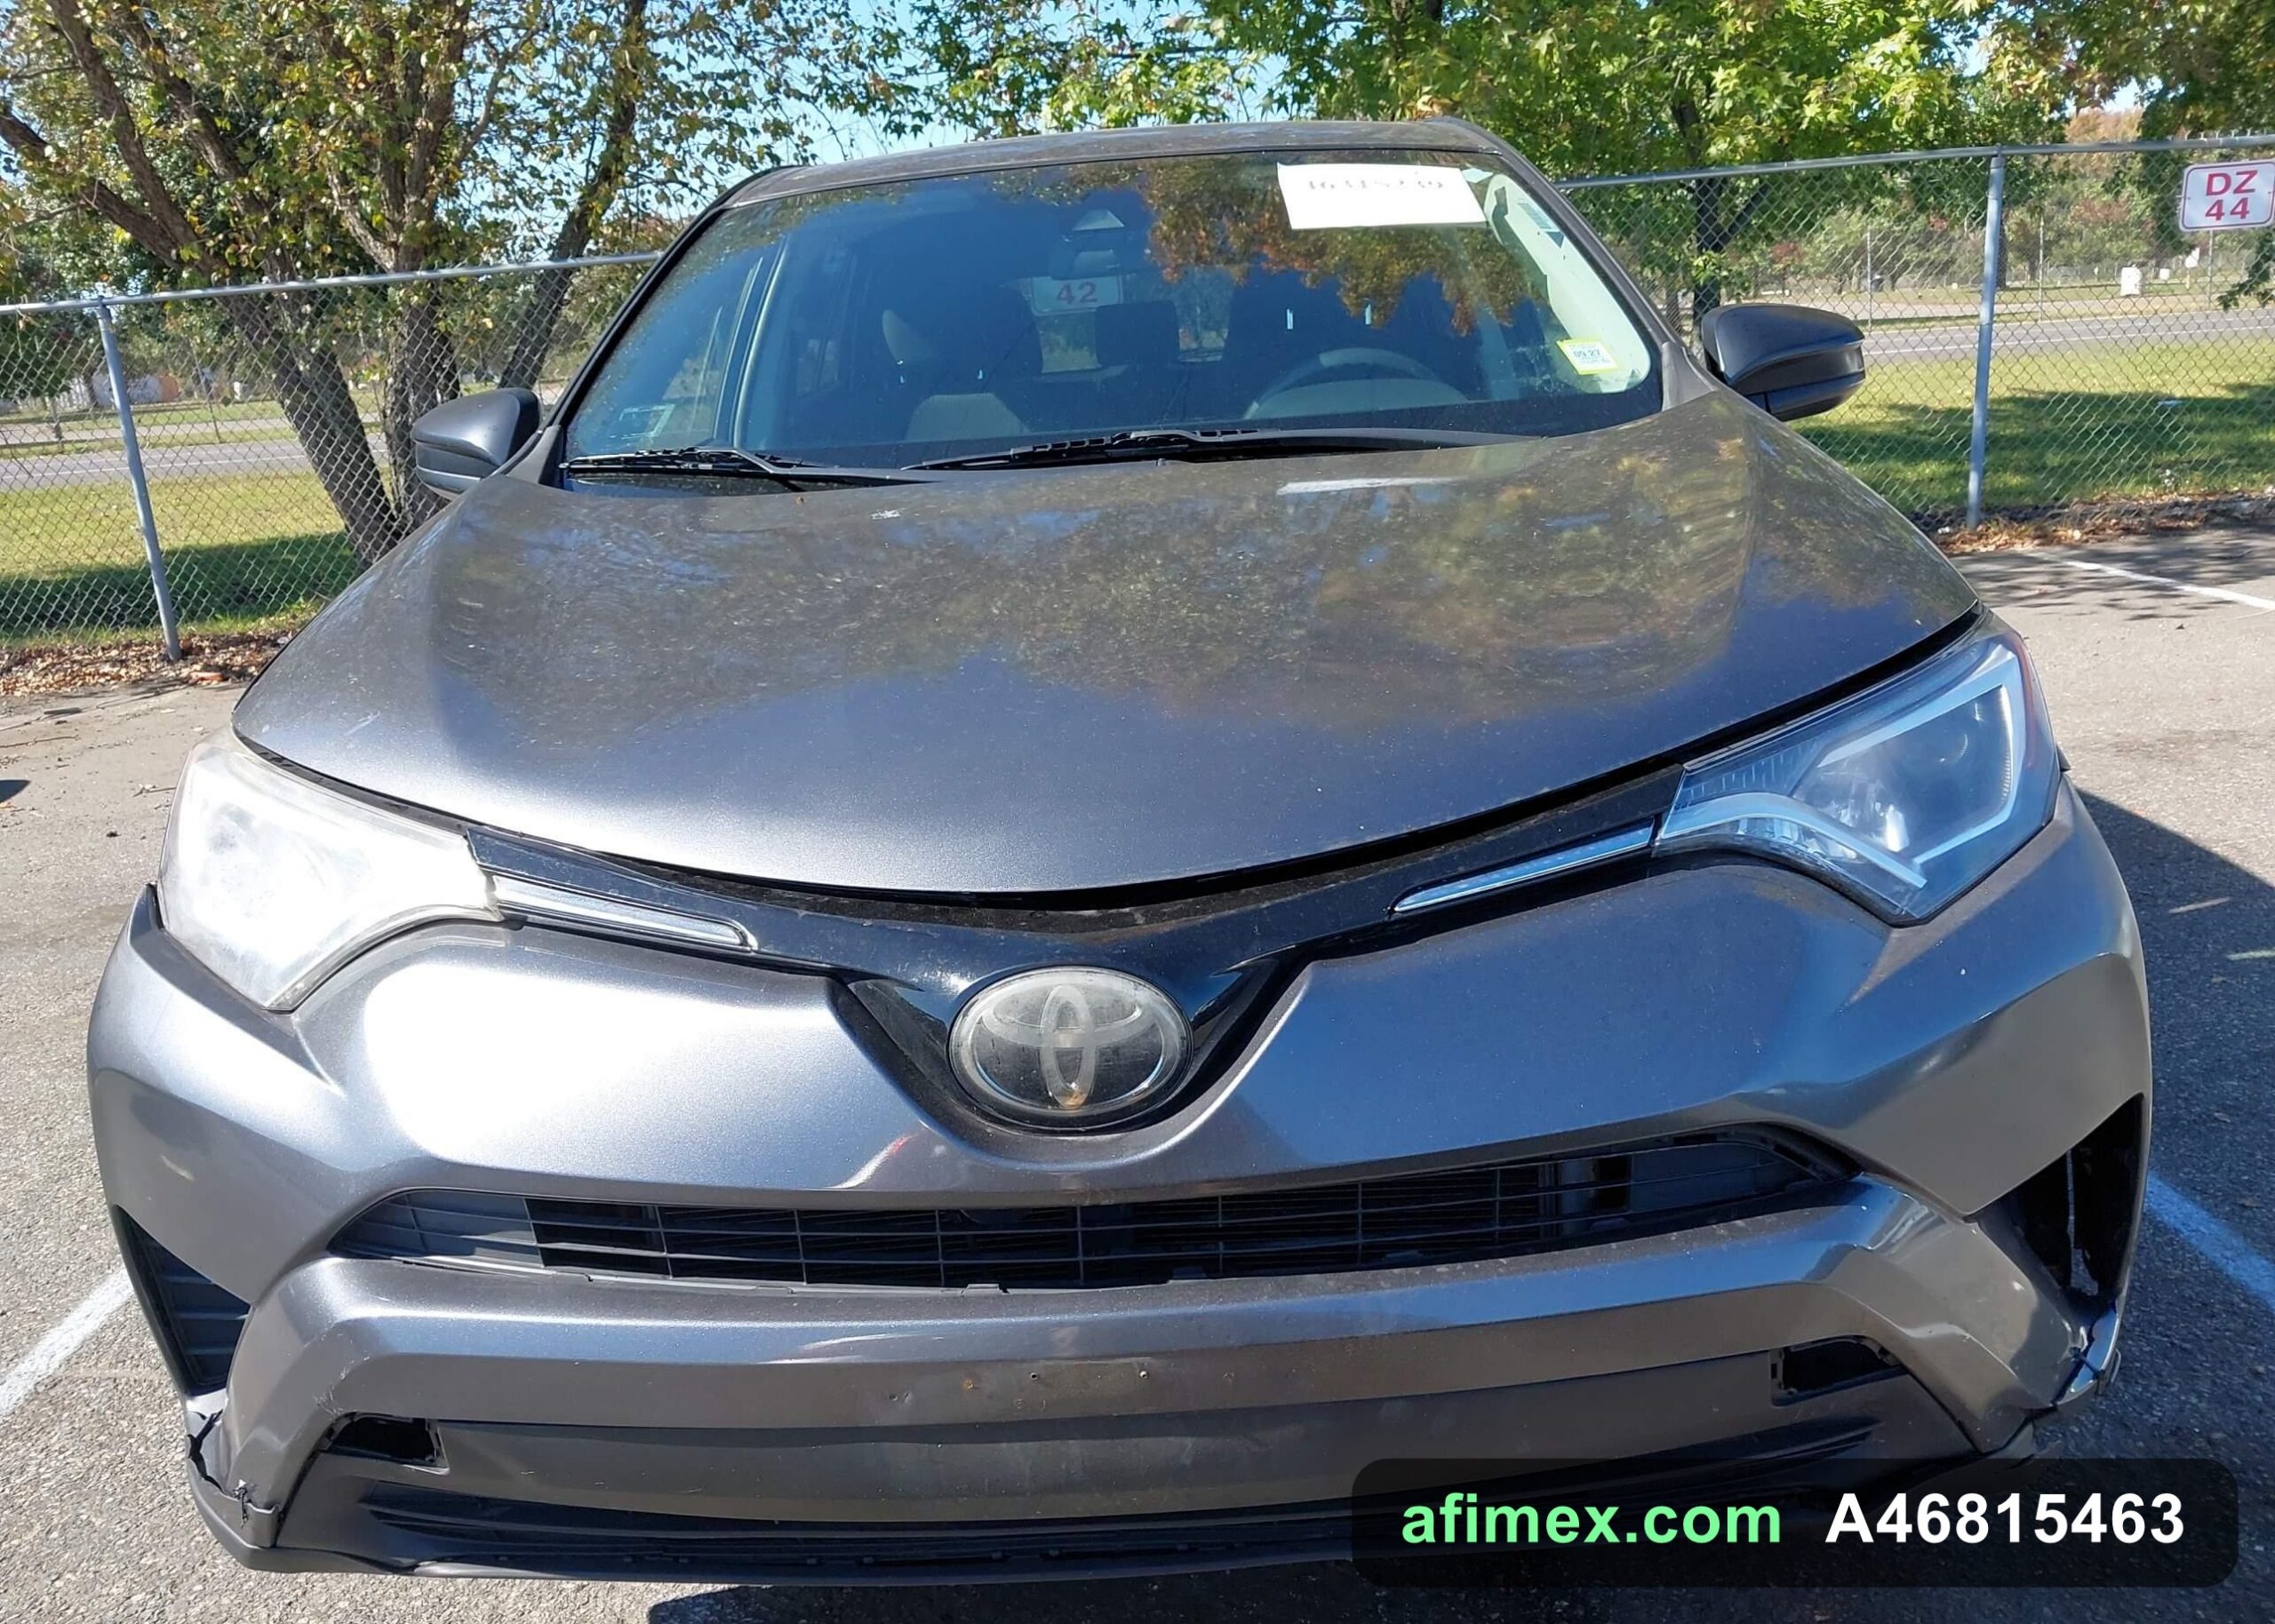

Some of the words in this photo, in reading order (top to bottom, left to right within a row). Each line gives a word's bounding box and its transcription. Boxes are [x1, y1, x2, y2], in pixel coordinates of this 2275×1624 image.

[2206, 170, 2258, 196] DZ
[2205, 197, 2250, 221] 44
[1057, 282, 1098, 305] 42
